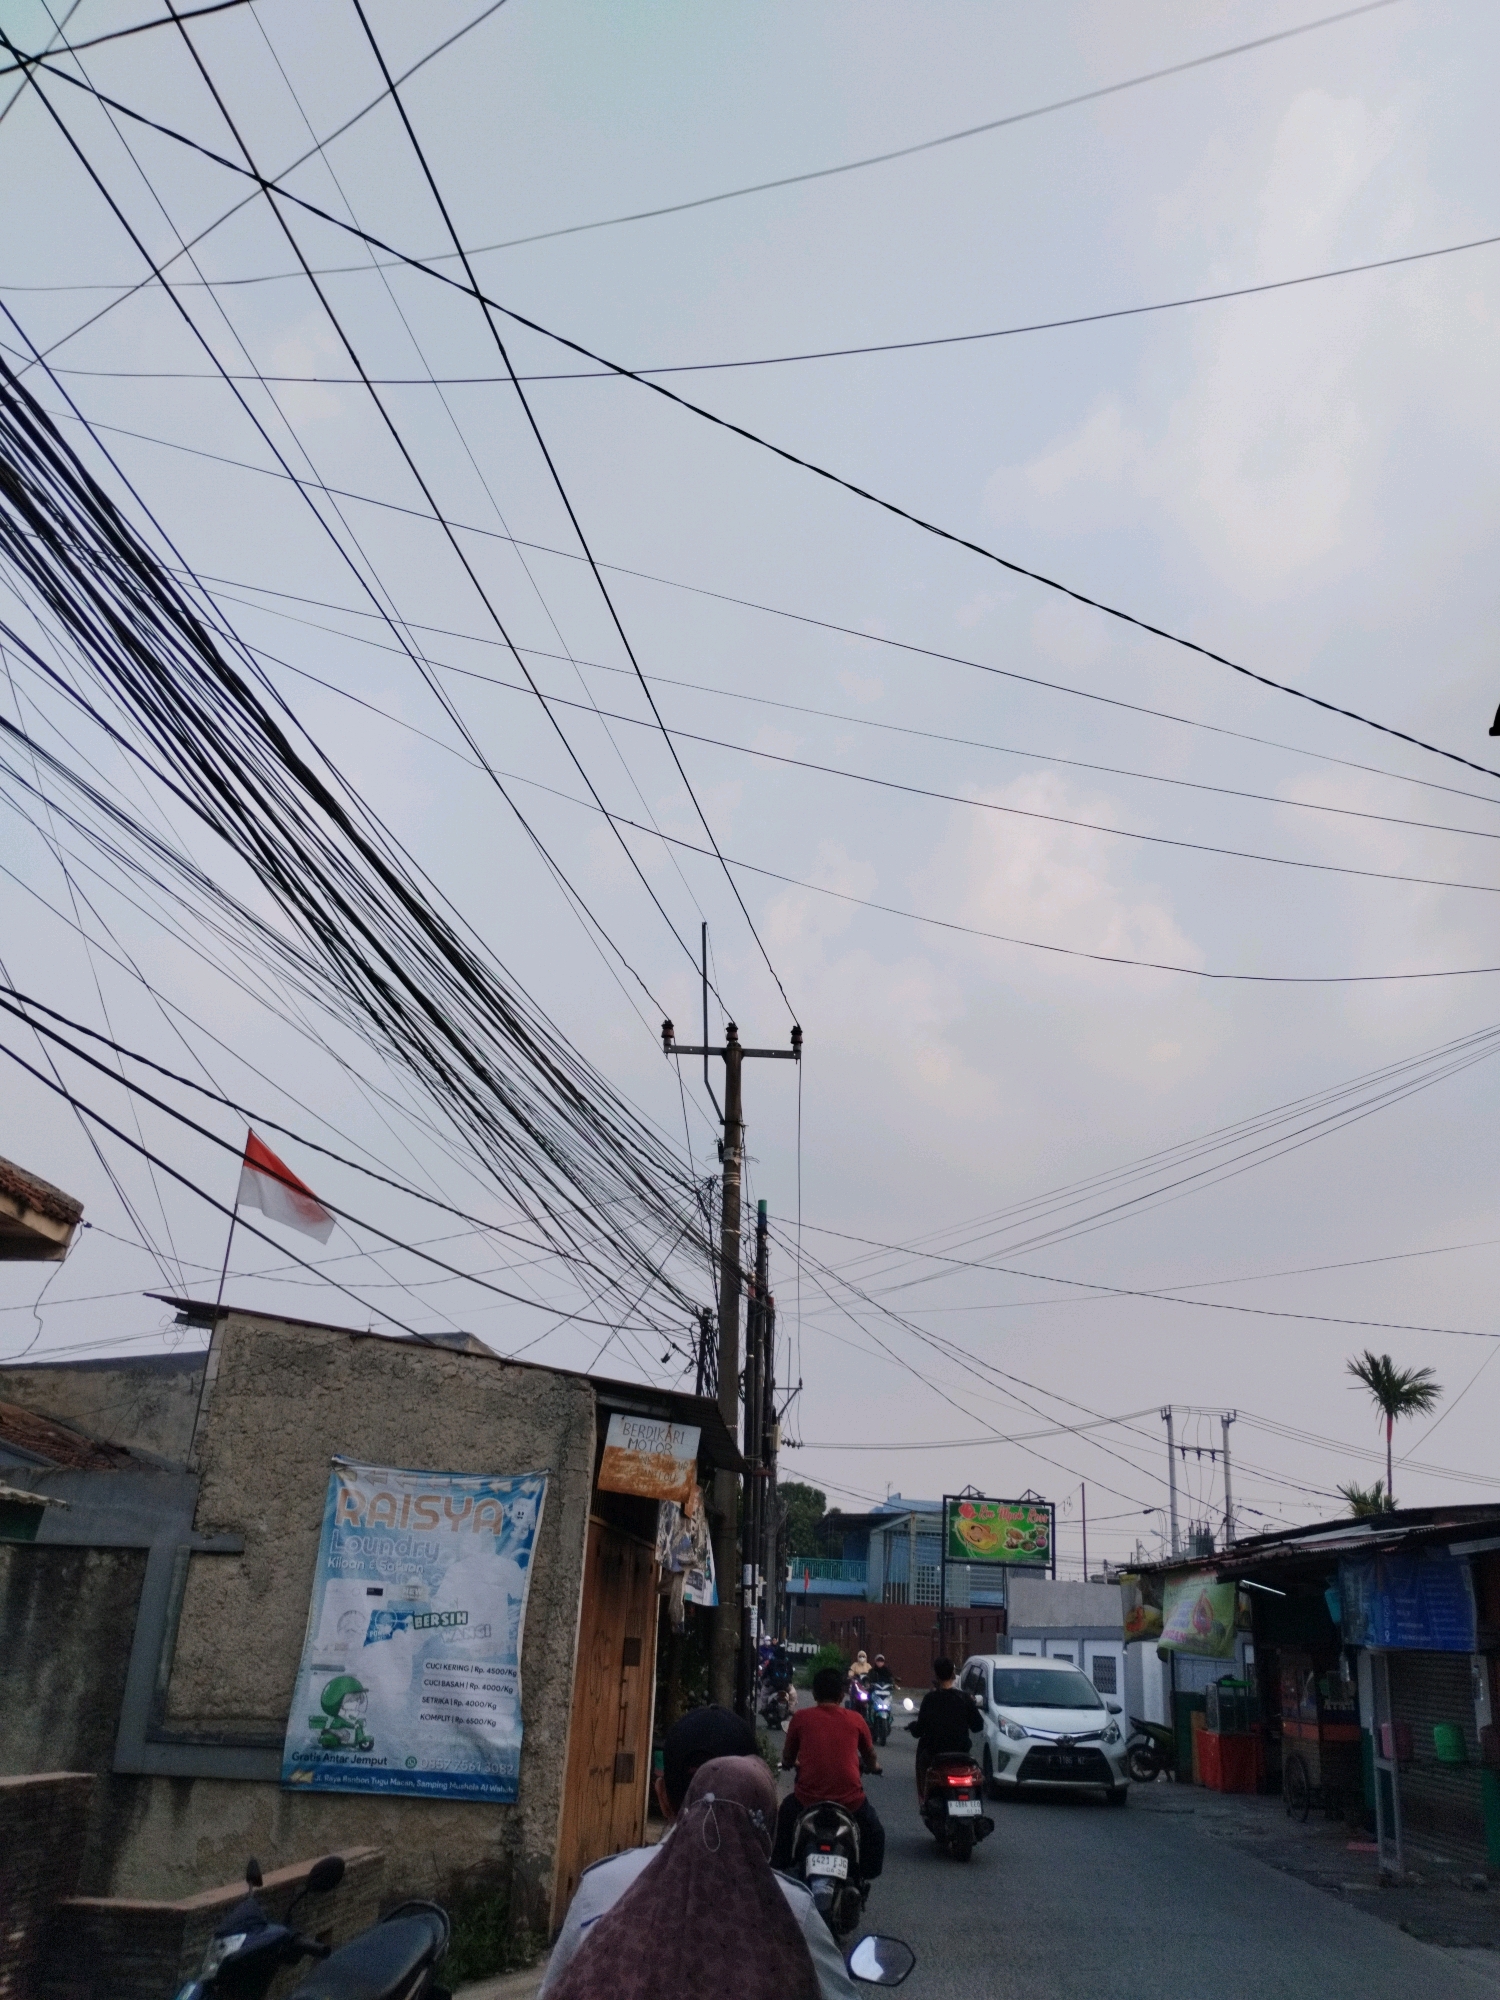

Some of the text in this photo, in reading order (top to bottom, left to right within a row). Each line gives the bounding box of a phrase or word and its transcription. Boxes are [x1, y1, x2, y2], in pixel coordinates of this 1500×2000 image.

[623, 1422, 685, 1444] BERDIKARI
[628, 1437, 673, 1455] MOTOR
[335, 1487, 504, 1537] RAISYA
[330, 1529, 440, 1564] Loundry
[328, 1556, 365, 1570] Kiloan
[414, 1611, 468, 1630] BERSIH
[441, 1624, 491, 1644] WANGI
[425, 1662, 442, 1670] CUCI
[443, 1663, 469, 1672] KERING
[486, 1667, 518, 1678] 4500/Kg
[424, 1679, 441, 1687] CUCI
[441, 1680, 465, 1688] BASAH
[482, 1684, 514, 1694] 4000/Kg
[422, 1696, 450, 1705] SETRIKA
[465, 1700, 497, 1710] 4000/Kg
[420, 1713, 450, 1722] KOMPLIT
[466, 1717, 497, 1727] 6500/Kg
[292, 1751, 388, 1766] Gratis Antar Jemput
[421, 1757, 452, 1770] 0857
[324, 1774, 341, 1783] Raya
[371, 1776, 389, 1787] Tugu
[416, 1779, 448, 1790] Samping
